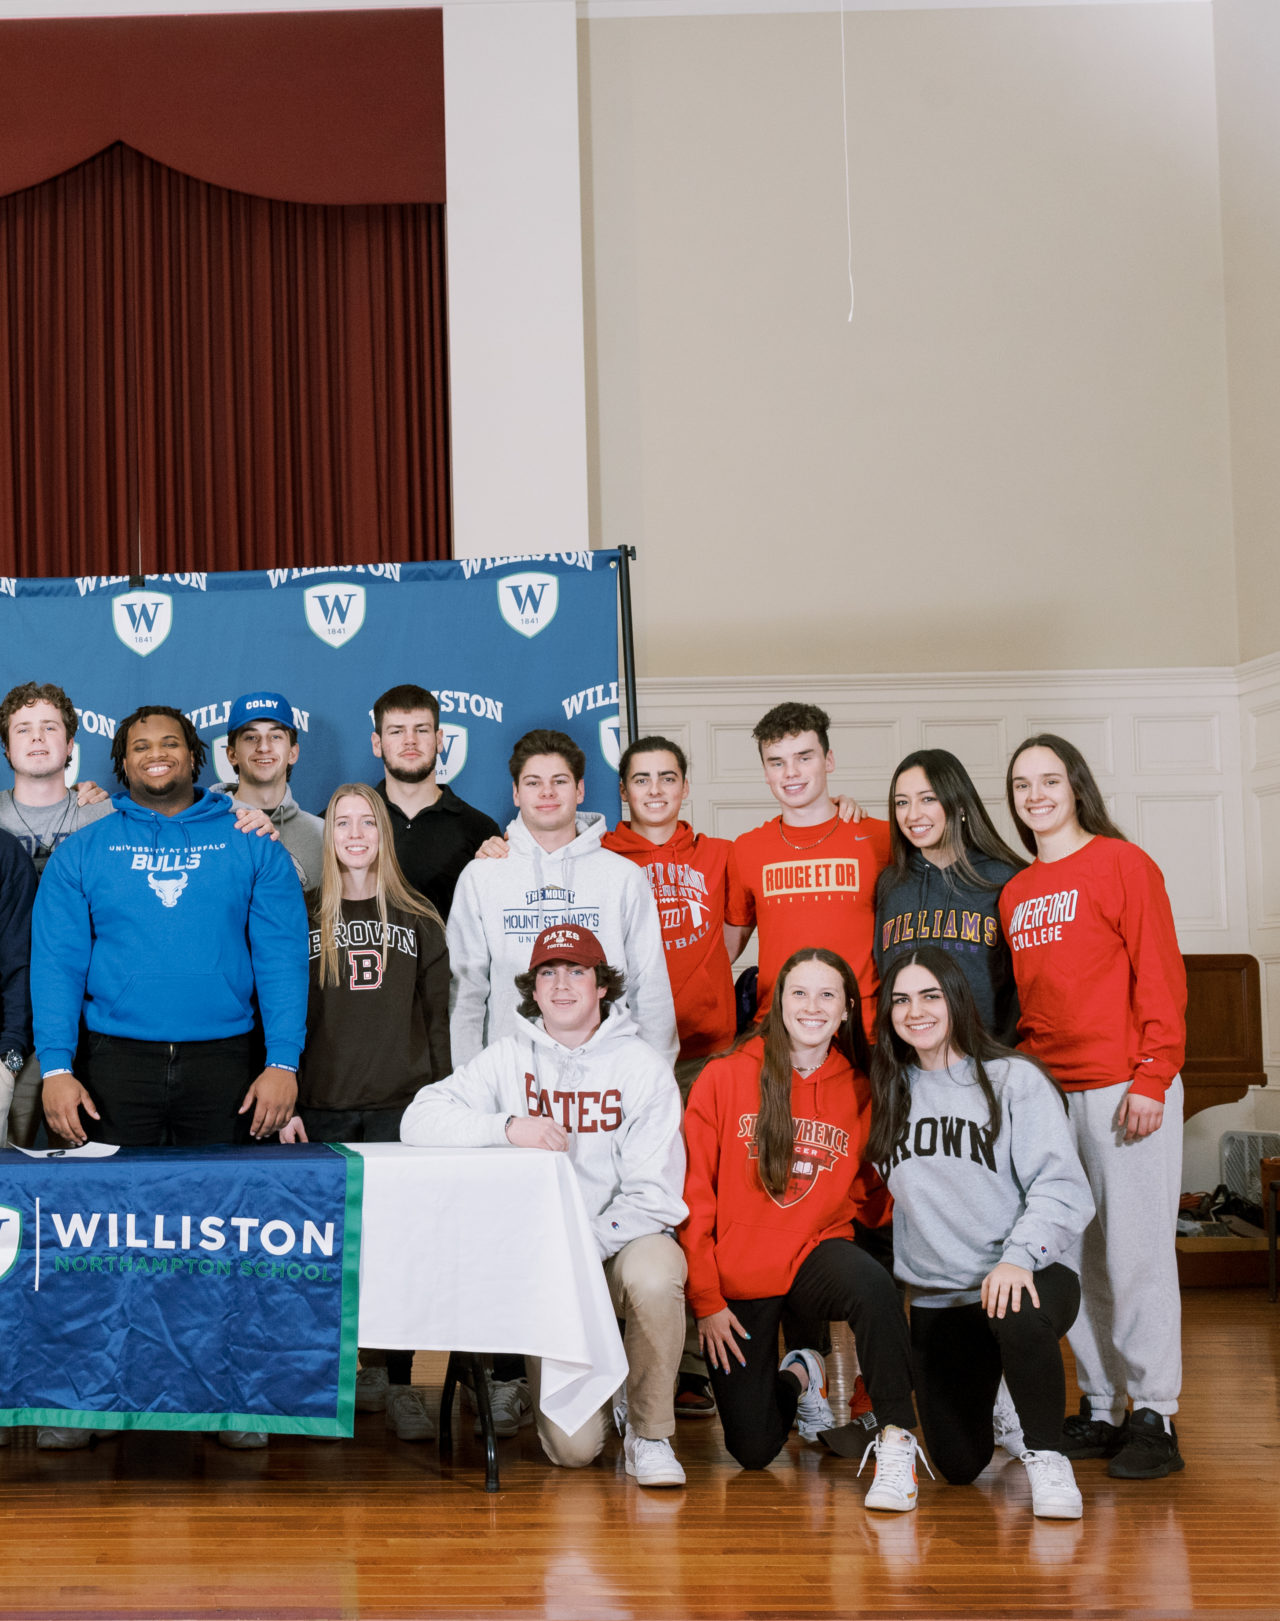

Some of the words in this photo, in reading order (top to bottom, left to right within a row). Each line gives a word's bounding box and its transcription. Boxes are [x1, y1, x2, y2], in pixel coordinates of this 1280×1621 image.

[312, 593, 358, 625] W
[505, 583, 550, 615] W
[120, 602, 164, 633] W
[520, 617, 539, 625] 1841
[134, 636, 153, 644] 1841
[246, 699, 279, 710] COLBY
[109, 844, 166, 854] UNIVERSITY
[184, 843, 226, 854] BUFFALO
[131, 853, 201, 872] BULLS
[765, 865, 812, 892] ROUGE
[815, 864, 832, 888] ET
[835, 863, 856, 887] OR
[545, 888, 576, 904] MOUT
[503, 914, 540, 930] MOUNT
[882, 909, 998, 952] WILLIAMS
[543, 929, 580, 945] BATES
[1012, 924, 1062, 952] COLLEGE
[348, 949, 382, 990] B
[524, 1072, 623, 1134] BATES
[51, 1212, 335, 1257] WILLISTON
[54, 1255, 231, 1276] NORTHAMPTON
[239, 1260, 333, 1282] SCHOOL
